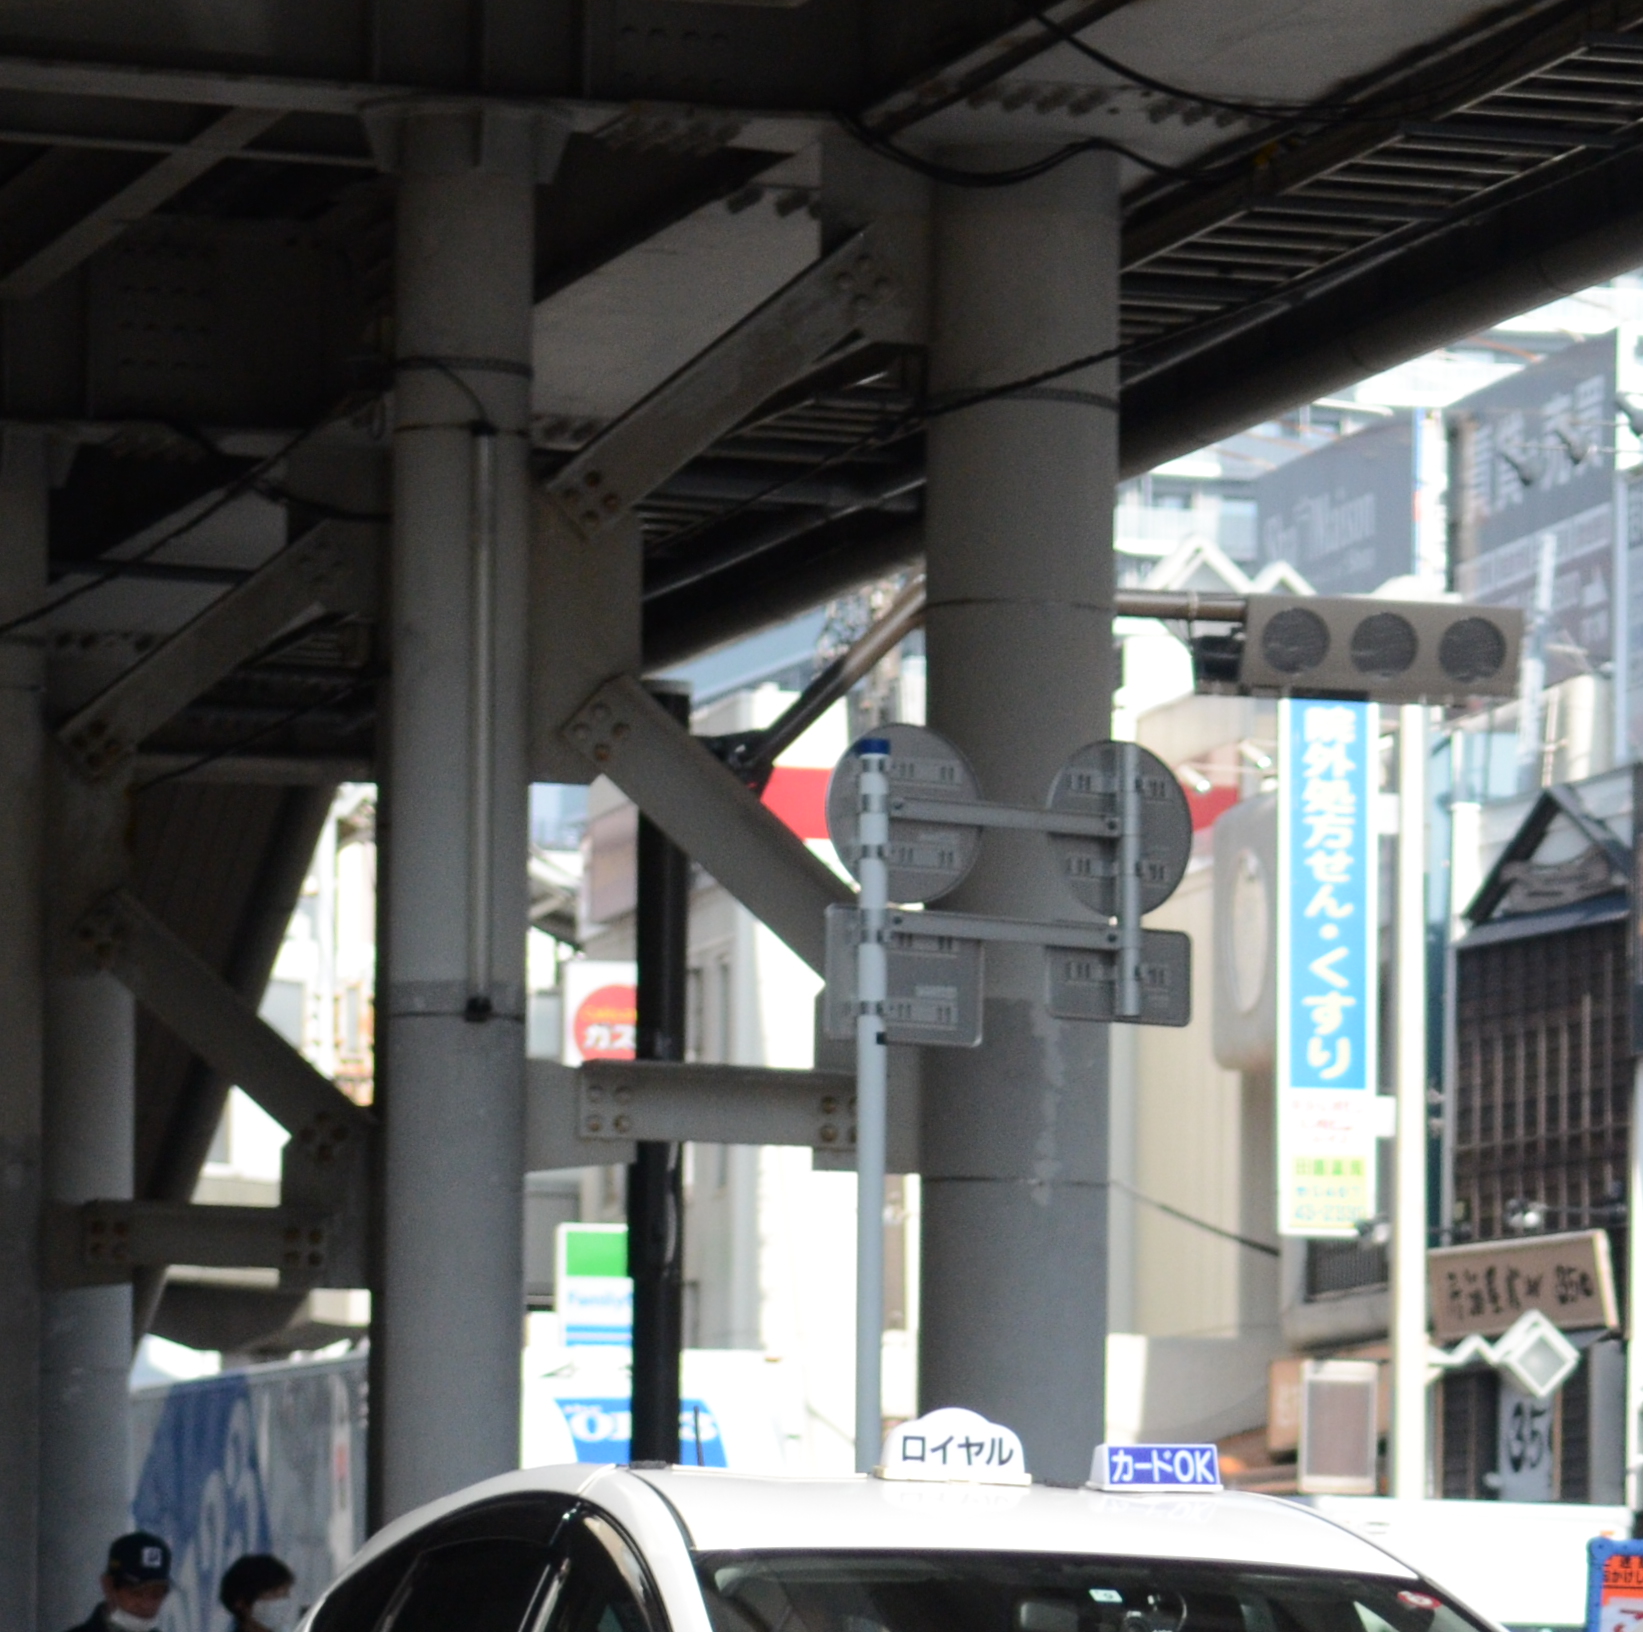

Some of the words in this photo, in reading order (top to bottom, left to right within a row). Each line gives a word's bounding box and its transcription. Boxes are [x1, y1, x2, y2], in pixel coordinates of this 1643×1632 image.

[902, 1434, 1015, 1467] ロイヤル
[1111, 1447, 1216, 1485] カードOK
